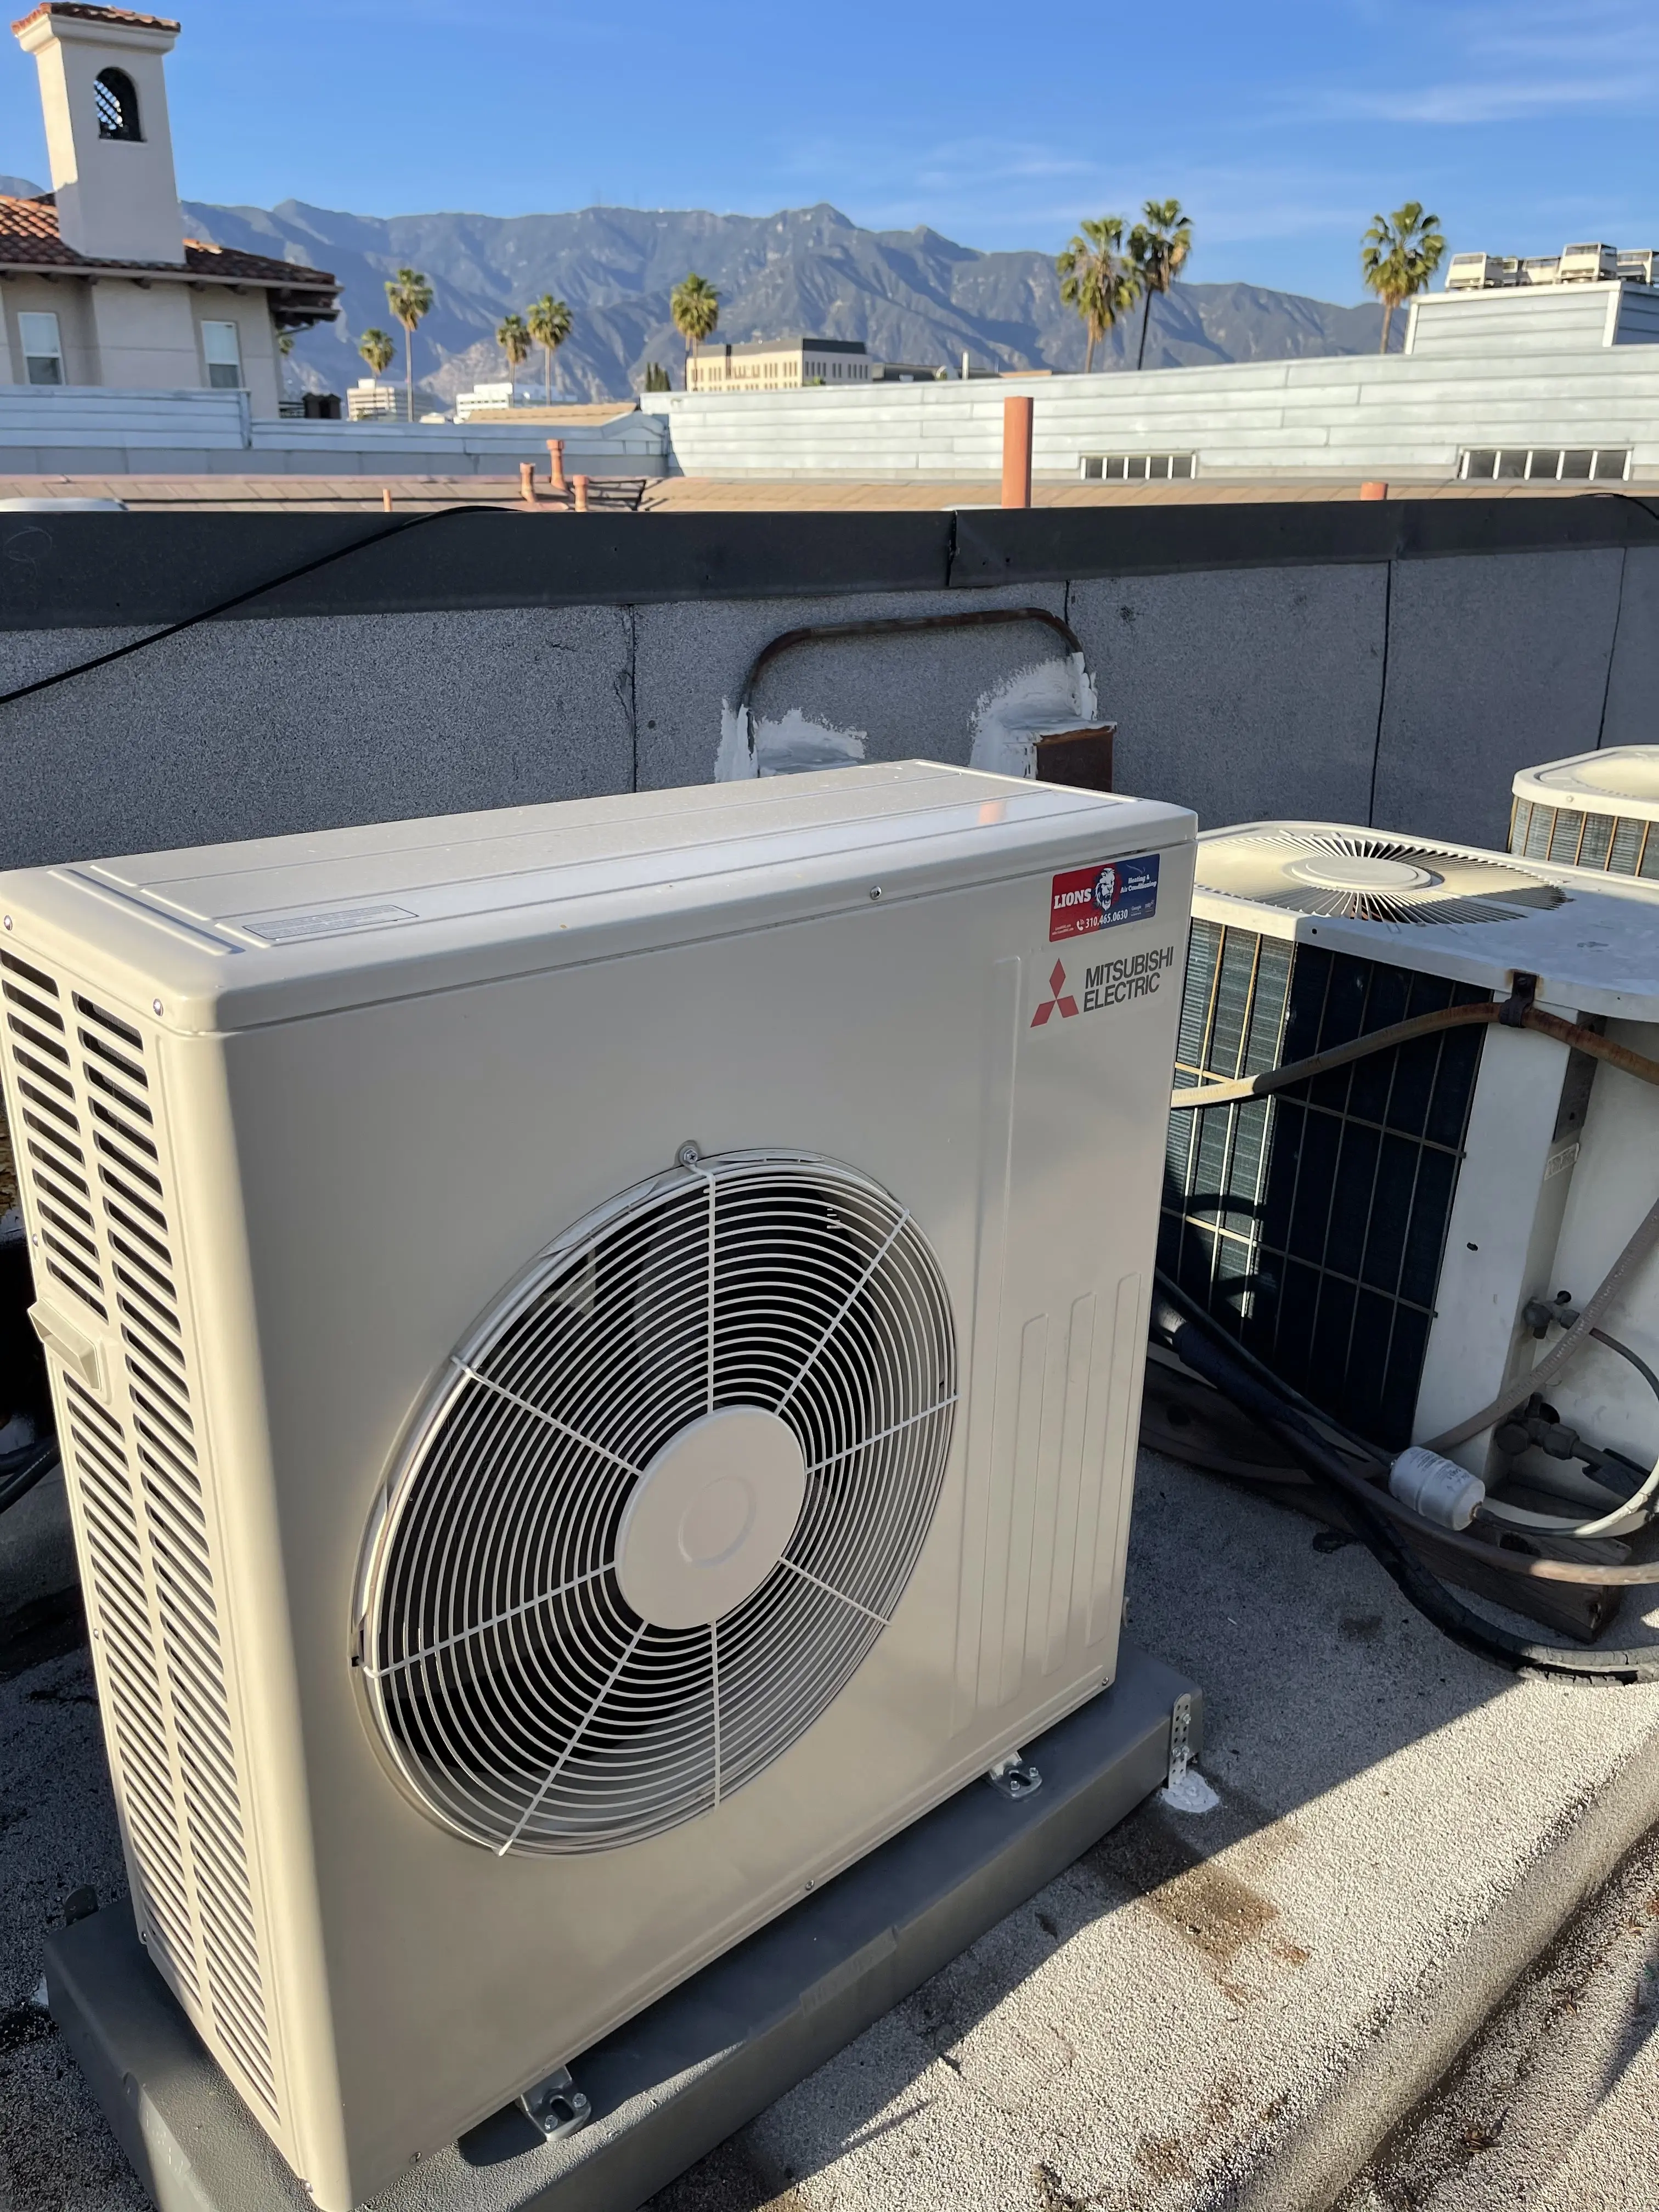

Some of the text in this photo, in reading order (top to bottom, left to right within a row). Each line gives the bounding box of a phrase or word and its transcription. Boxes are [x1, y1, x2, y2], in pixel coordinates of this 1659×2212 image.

[1128, 876, 1146, 884] Heating
[1128, 881, 1157, 891] Conditioning
[1053, 888, 1092, 909] LIONS
[1085, 909, 1128, 929] 310.465.0630
[1085, 946, 1174, 989] MITSUBISHI
[1084, 972, 1160, 1013] ELECTRIC
